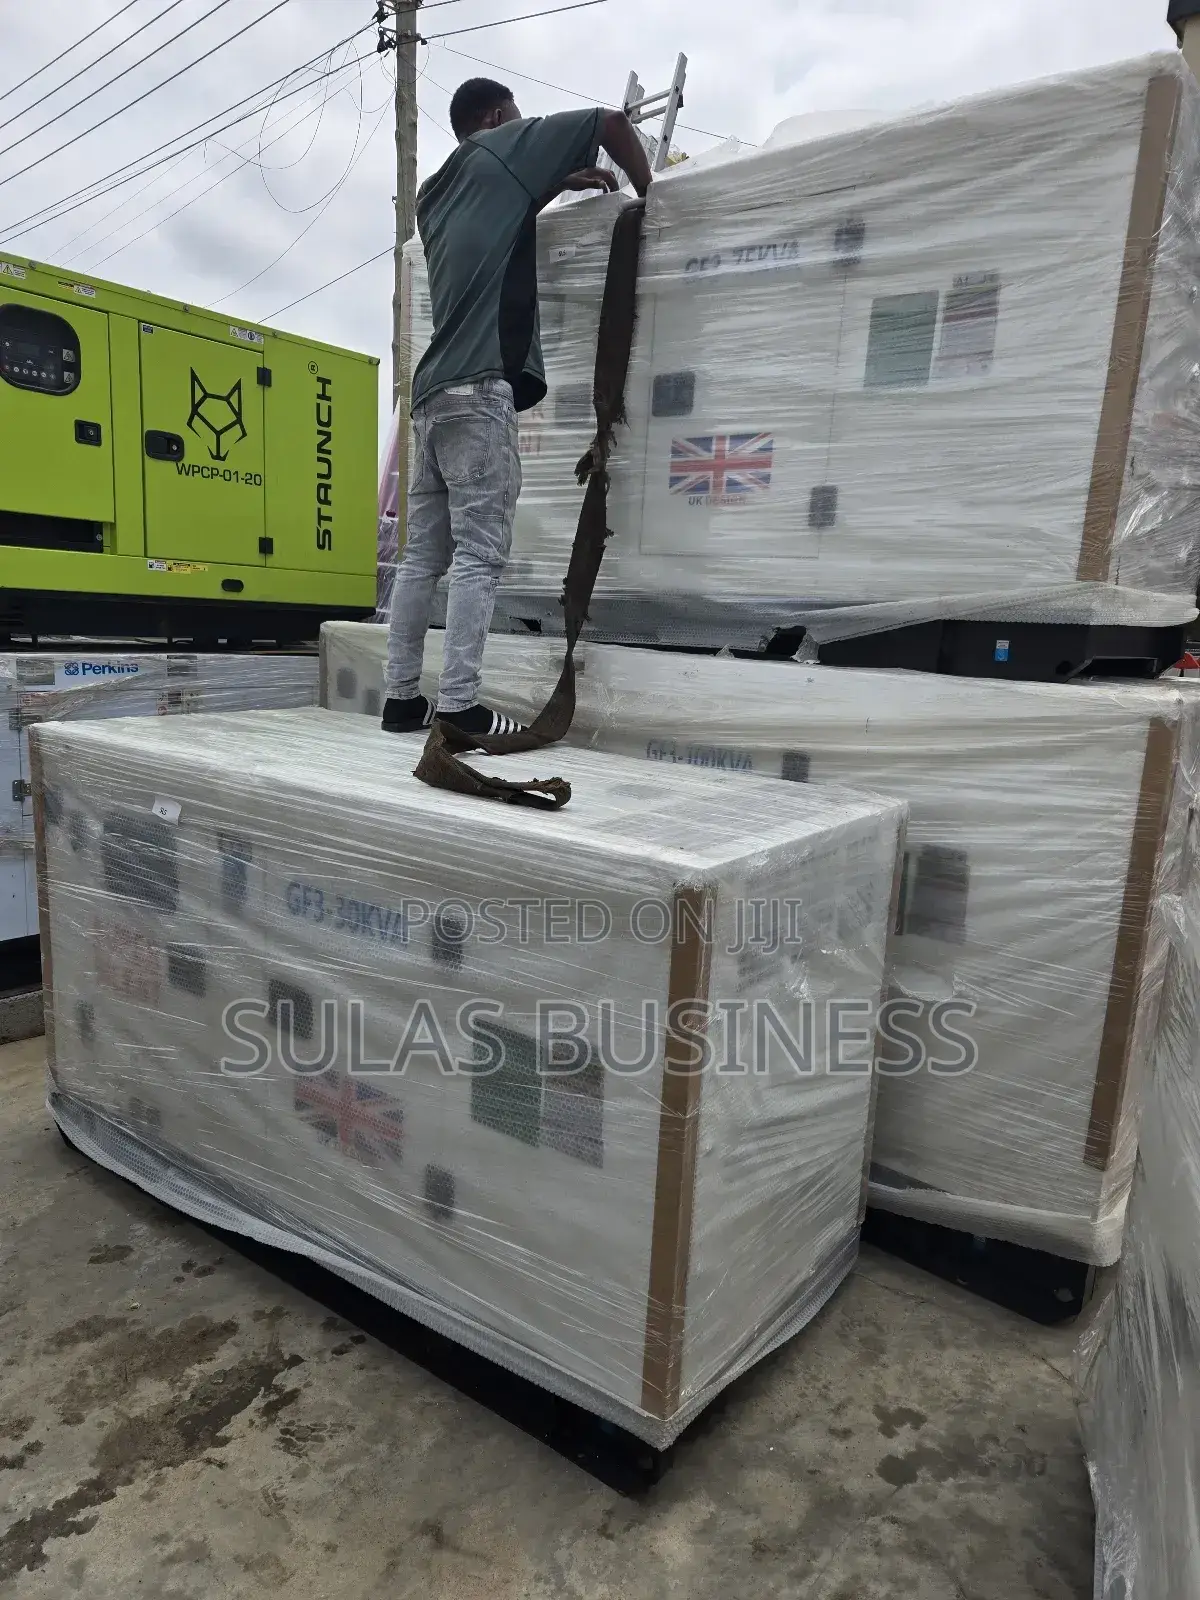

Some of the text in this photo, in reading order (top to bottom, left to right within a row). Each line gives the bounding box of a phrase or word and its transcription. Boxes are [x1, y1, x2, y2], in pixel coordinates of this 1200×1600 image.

[175, 462, 263, 487] WPCP-01-20
[316, 376, 333, 551] STAUNCH
[81, 660, 139, 676] Perkins
